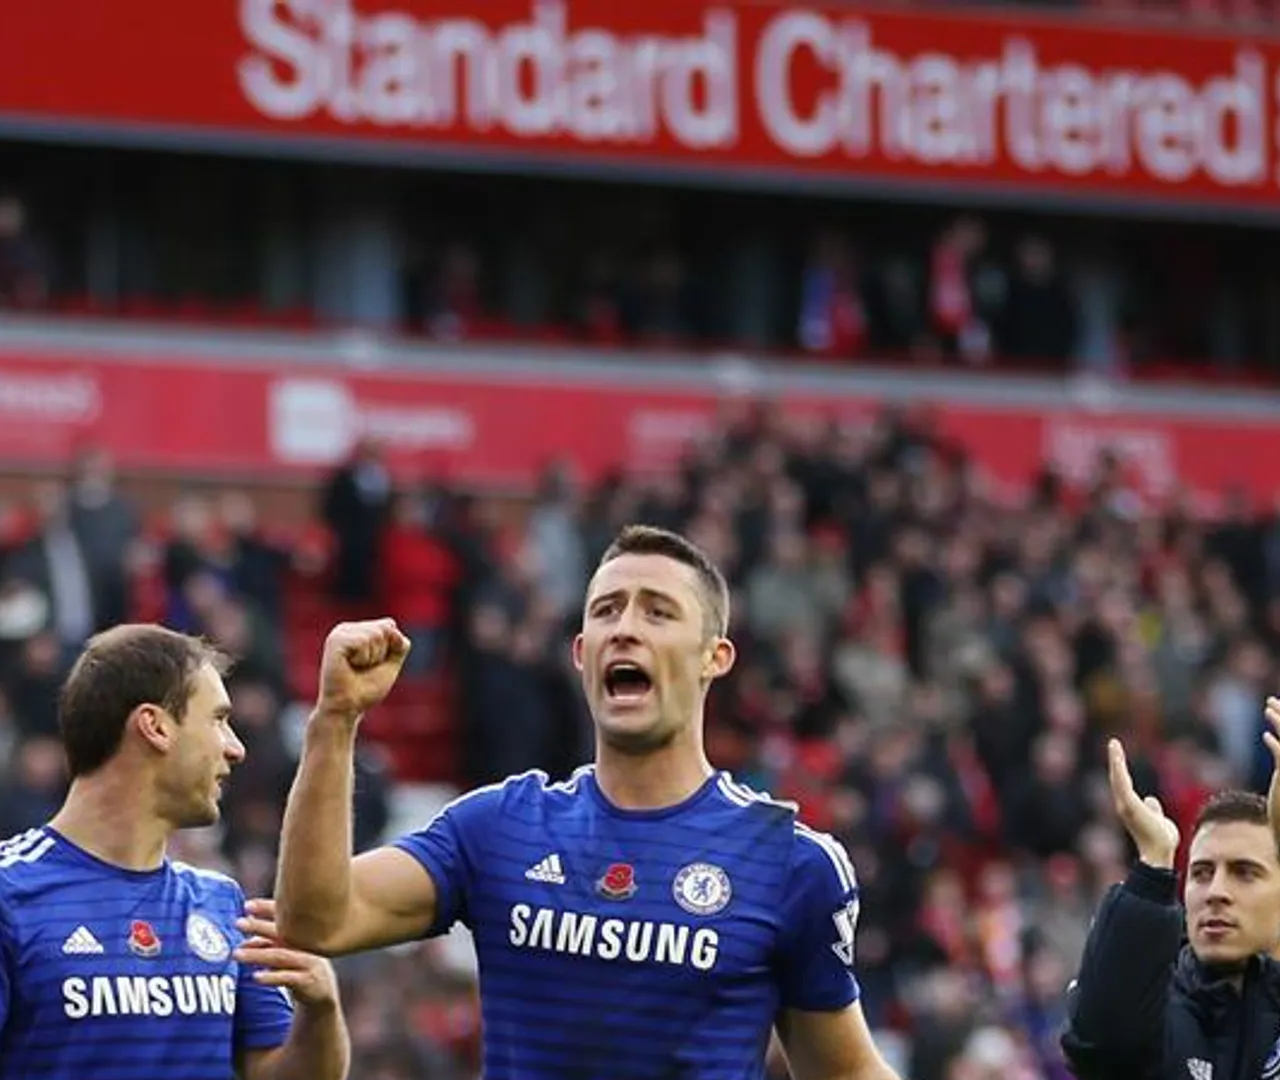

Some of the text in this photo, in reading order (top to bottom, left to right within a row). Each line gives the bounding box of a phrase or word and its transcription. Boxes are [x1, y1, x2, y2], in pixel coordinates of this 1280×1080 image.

[237, 0, 1267, 186] Standard Chartered
[508, 902, 719, 971] SAMSUNG
[62, 974, 236, 1019] SAMSUNG
